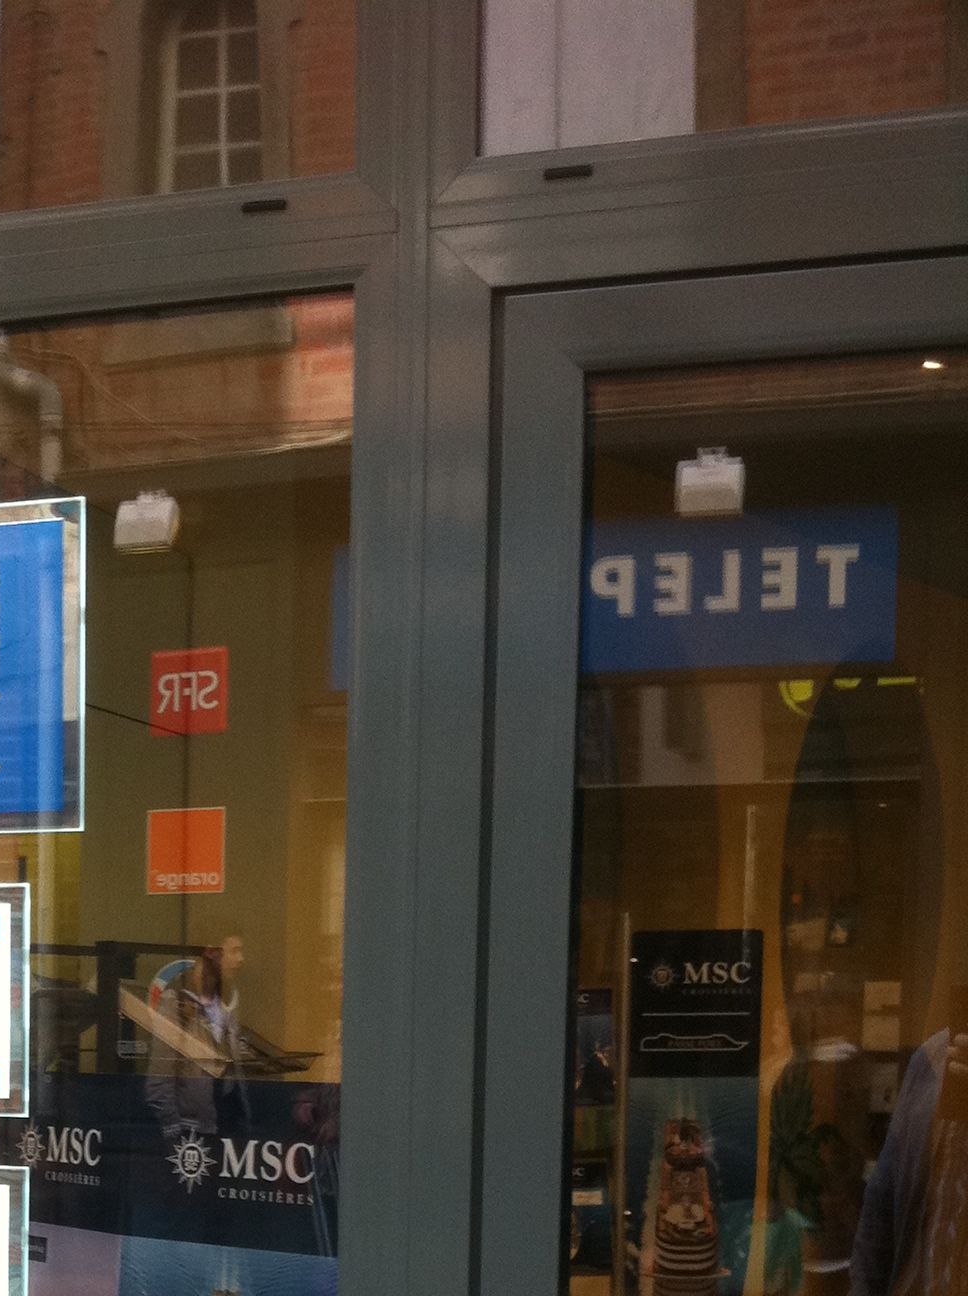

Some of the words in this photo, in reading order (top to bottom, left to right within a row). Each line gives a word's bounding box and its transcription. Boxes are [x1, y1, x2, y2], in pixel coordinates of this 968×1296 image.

[683, 961, 752, 985] MSC
[46, 1126, 102, 1167] MSC
[219, 1138, 315, 1184] MSC
[218, 1186, 315, 1206] CROISIÈRES
